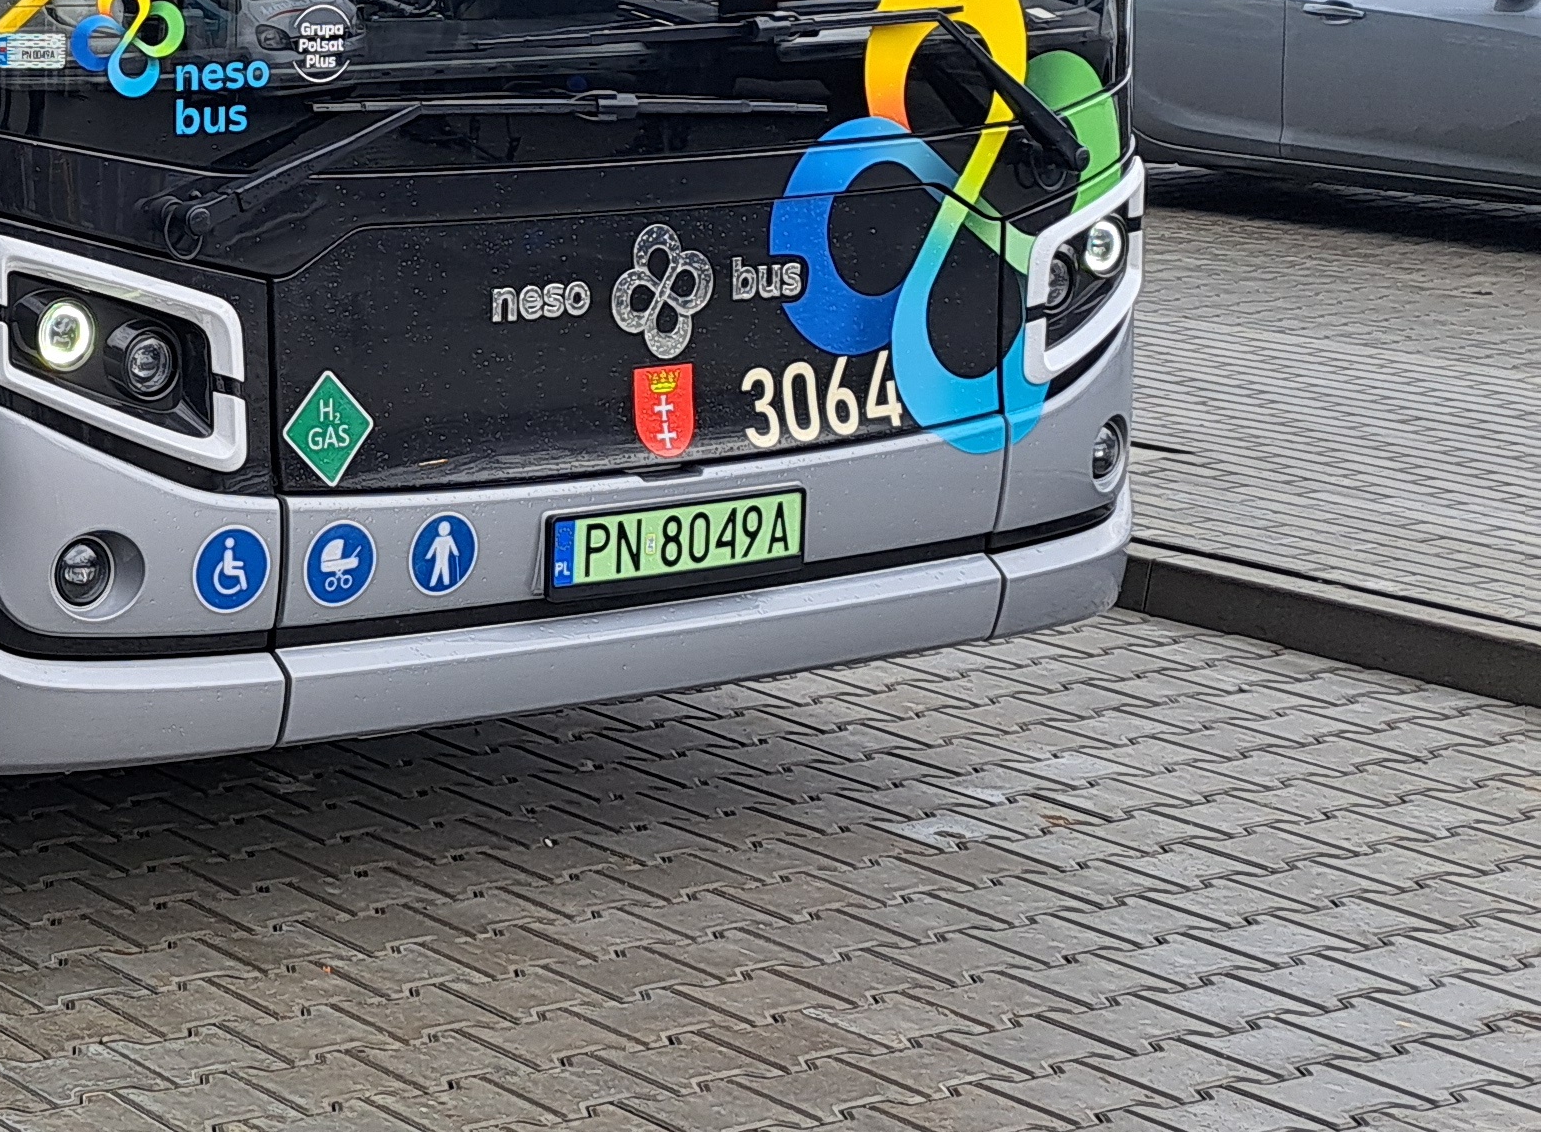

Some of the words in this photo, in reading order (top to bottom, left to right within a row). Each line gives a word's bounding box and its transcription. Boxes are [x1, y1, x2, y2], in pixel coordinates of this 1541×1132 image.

[298, 38, 345, 53] Polsat
[300, 22, 345, 39] Grupa
[174, 58, 271, 92] neso
[305, 54, 337, 68] Plus
[174, 99, 249, 136] bus
[491, 278, 591, 323] neso
[730, 257, 803, 302] bus
[741, 348, 903, 449] 3064
[308, 424, 350, 450] GAS
[554, 562, 571, 577] PL
[584, 518, 643, 578] PN
[660, 500, 790, 568] 8049A
